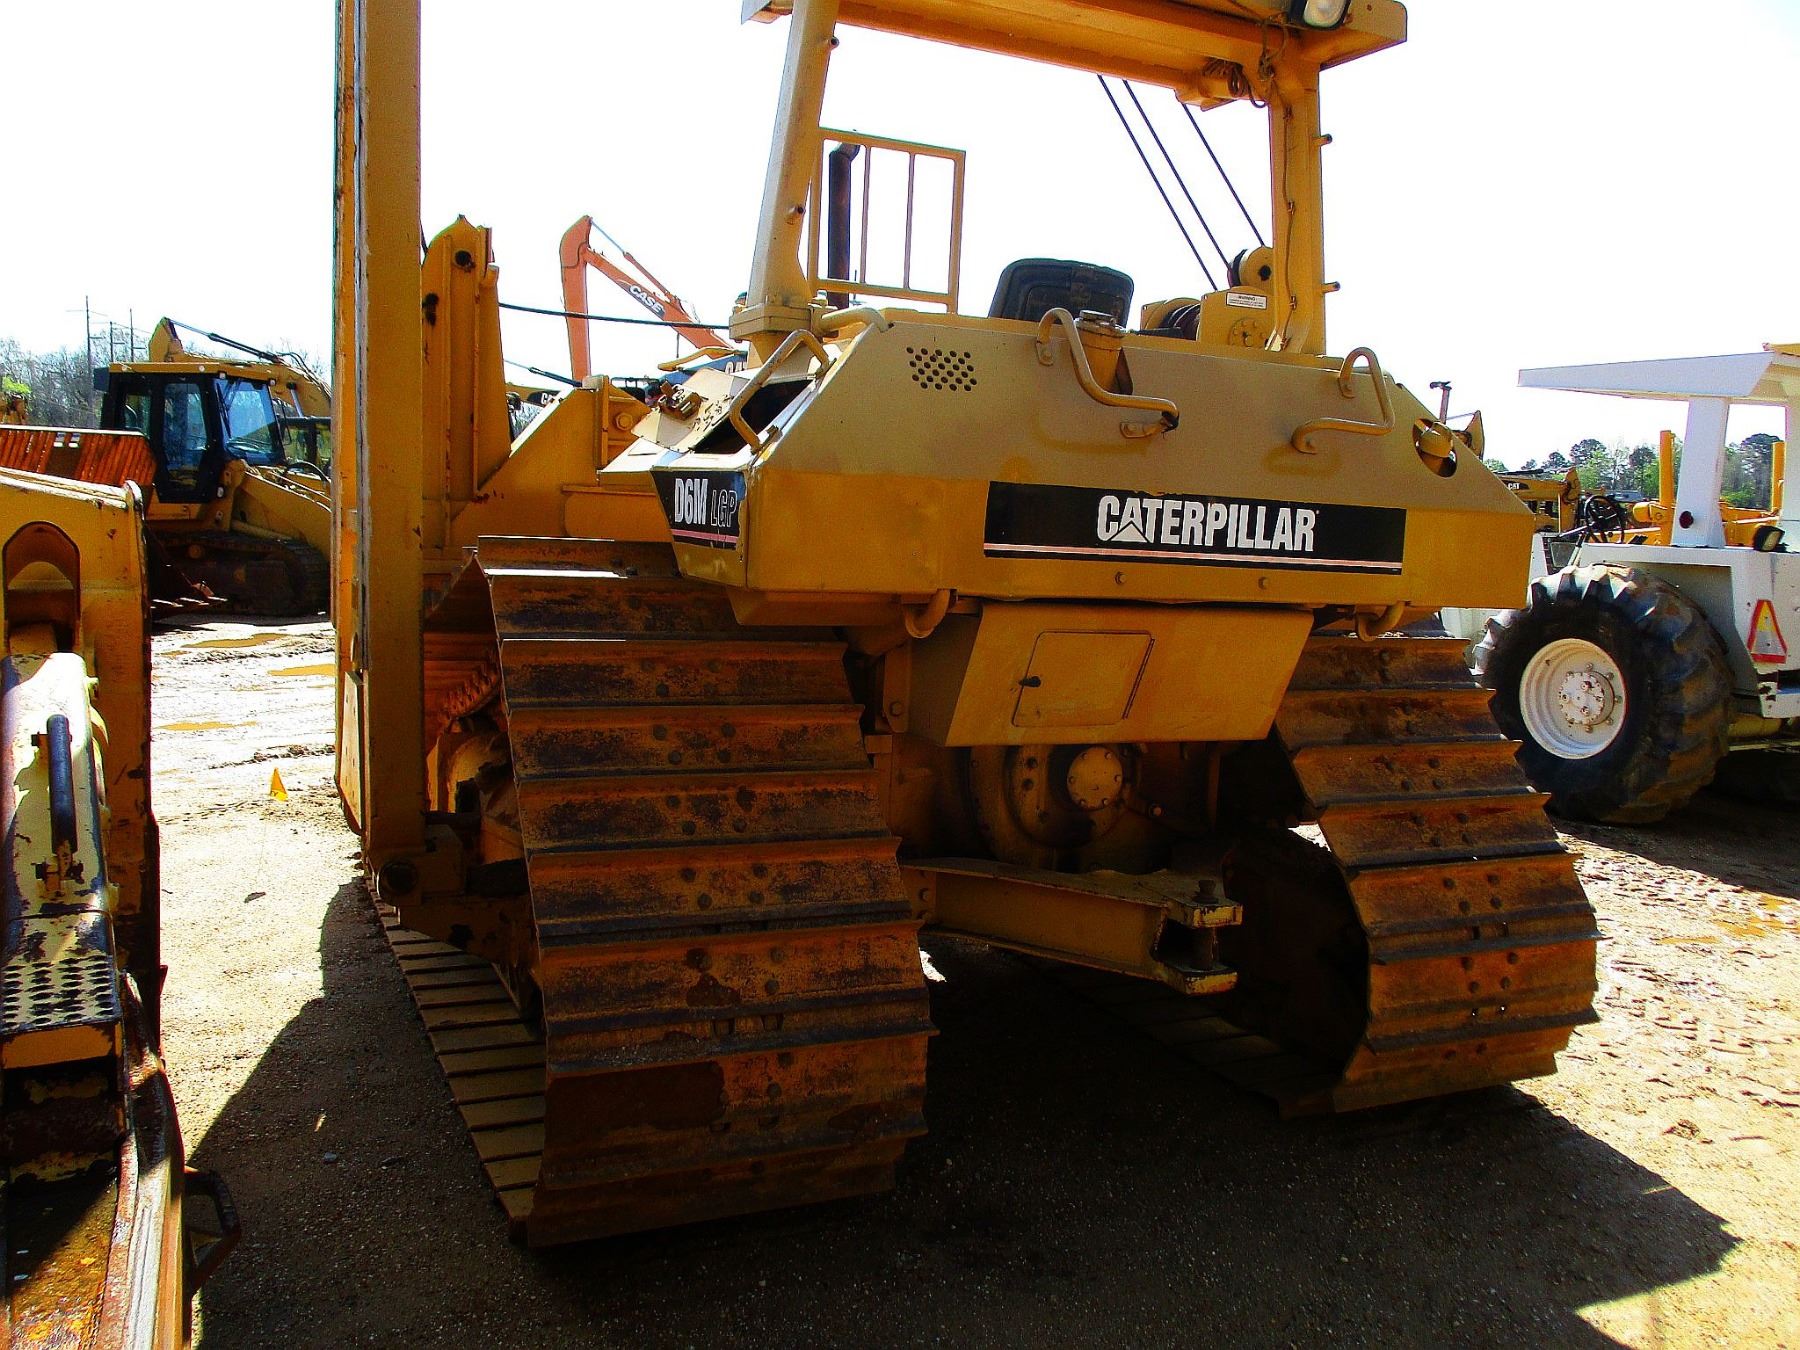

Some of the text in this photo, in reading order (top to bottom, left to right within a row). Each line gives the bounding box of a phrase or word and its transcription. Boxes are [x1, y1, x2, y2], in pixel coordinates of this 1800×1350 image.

[629, 285, 664, 313] CASE
[675, 478, 738, 528] D6M LGP
[1507, 482, 1520, 490] CAT
[1096, 495, 1316, 552] CATERPILLAR
